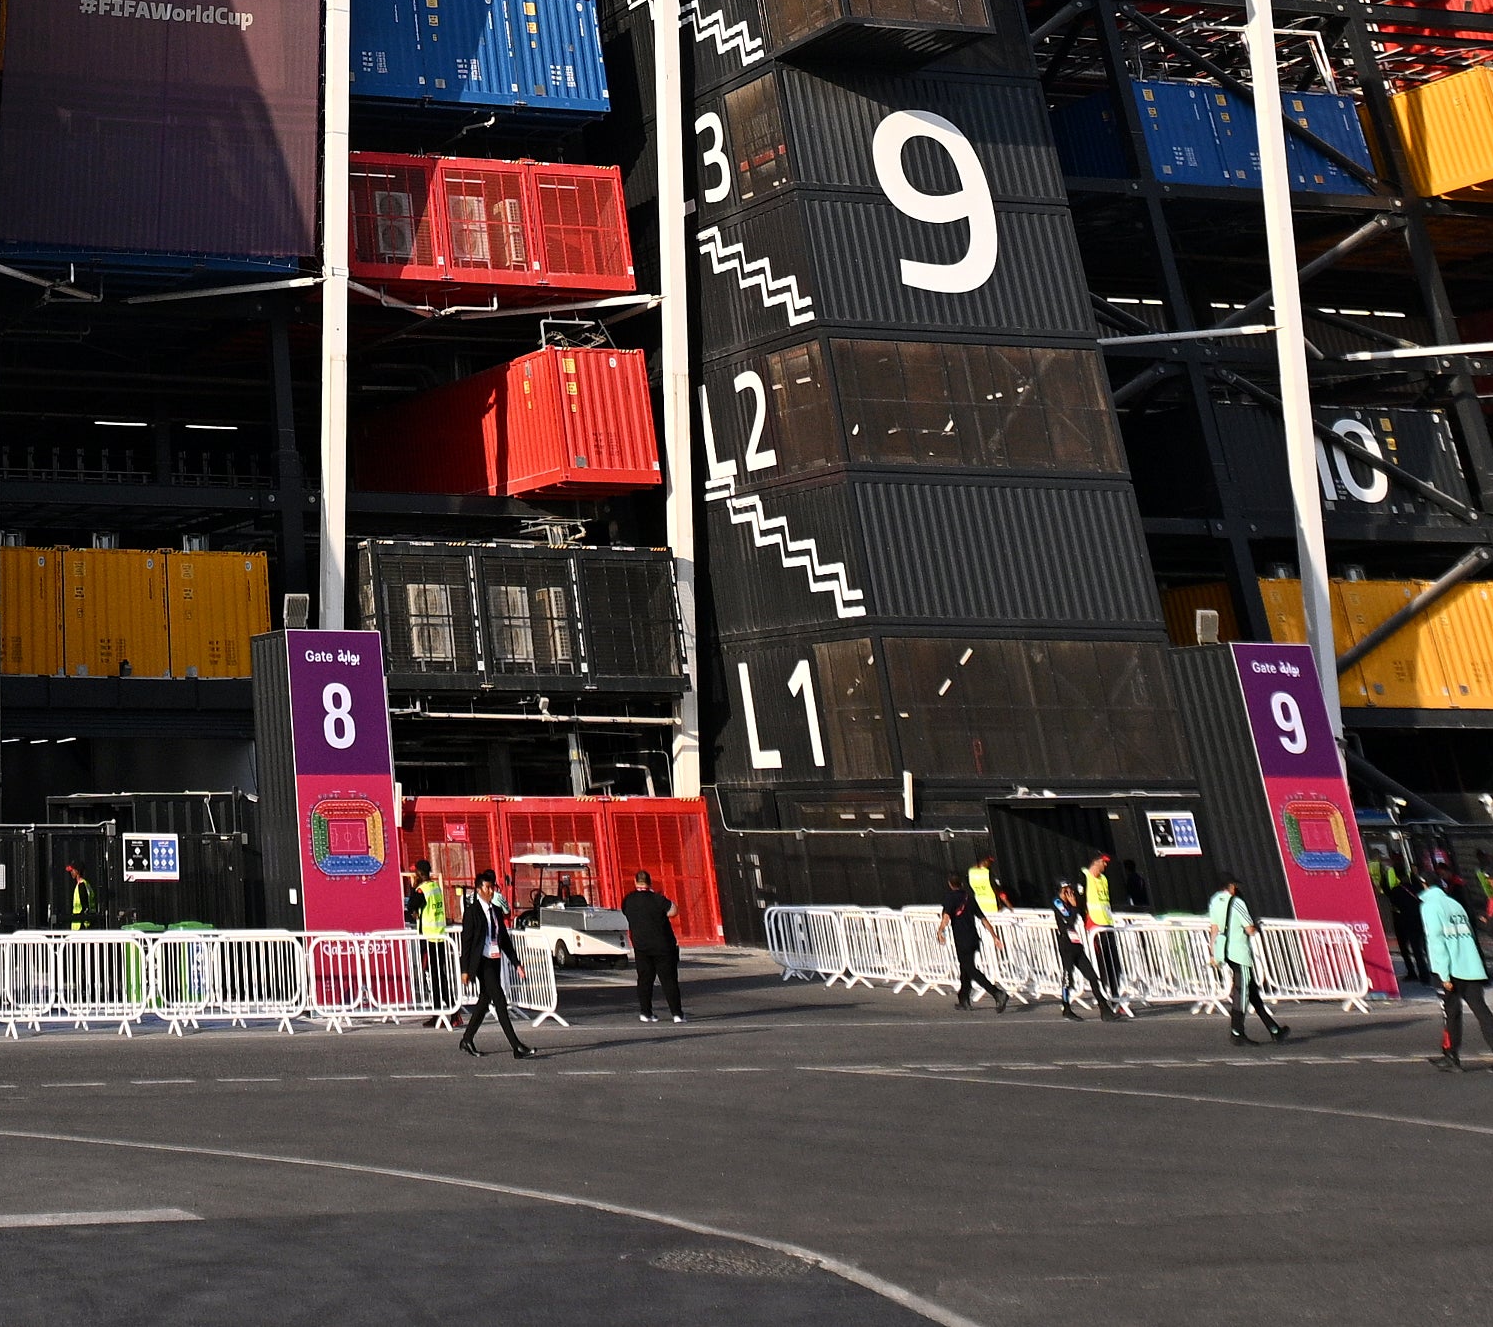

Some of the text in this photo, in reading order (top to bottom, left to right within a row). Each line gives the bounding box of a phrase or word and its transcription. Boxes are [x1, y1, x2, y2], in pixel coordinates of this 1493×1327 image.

[872, 109, 999, 295] 9
[697, 369, 778, 479] L2
[305, 650, 333, 662] Gate
[337, 649, 360, 666] بوابة
[1251, 660, 1277, 674] Gate
[322, 682, 356, 750] 8
[737, 659, 827, 770] L1
[1270, 691, 1308, 755] 9
